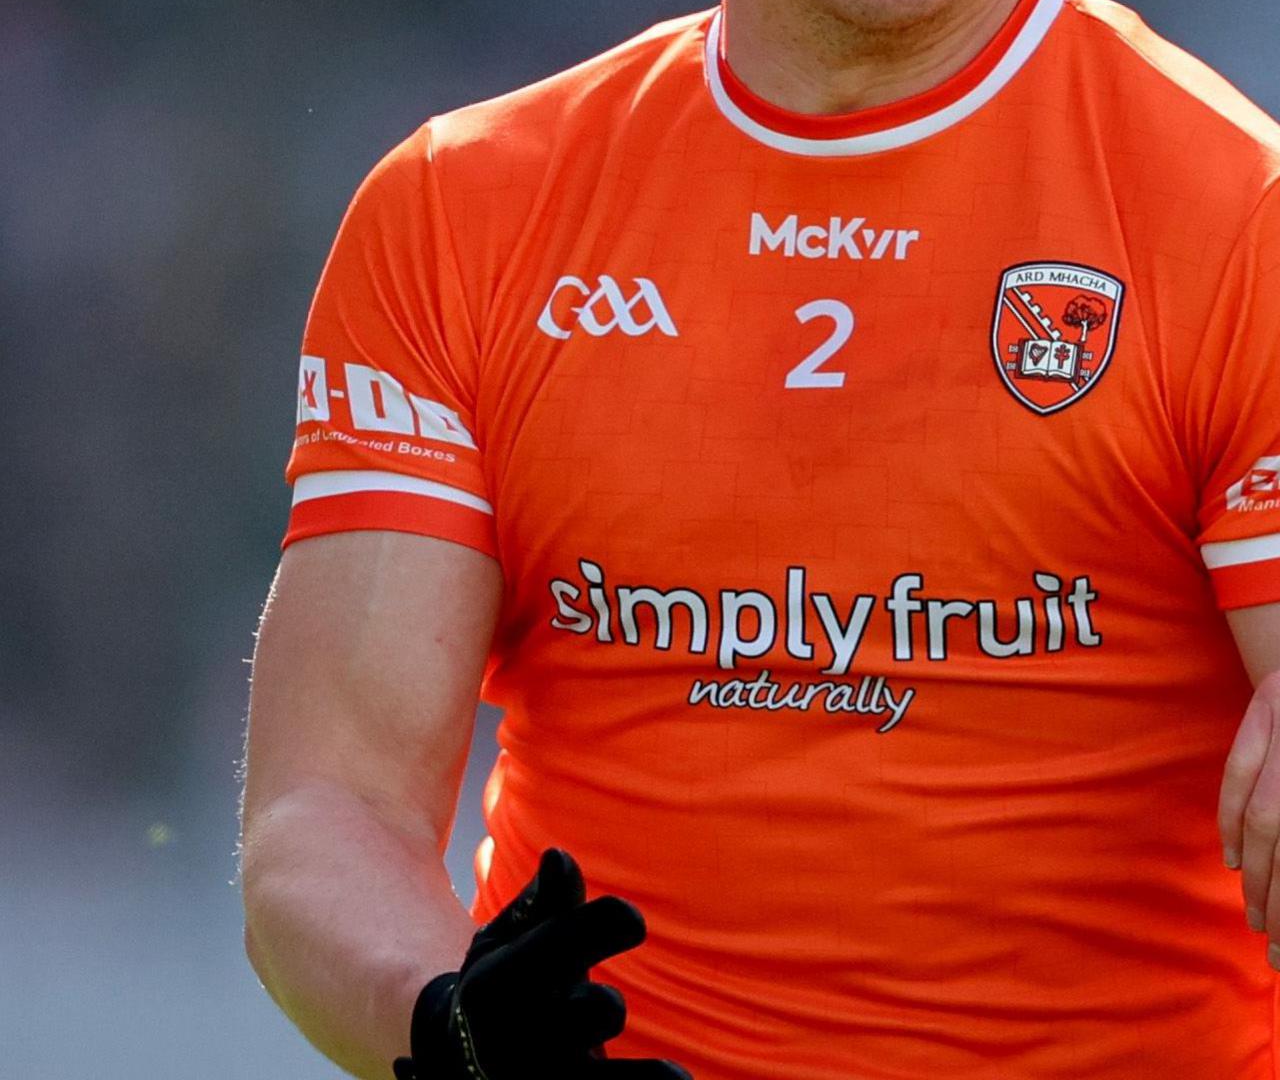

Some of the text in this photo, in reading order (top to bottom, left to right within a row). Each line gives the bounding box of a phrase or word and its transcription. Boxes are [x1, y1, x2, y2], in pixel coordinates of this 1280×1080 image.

[1016, 271, 1106, 291] ARD MHACHA
[784, 300, 855, 389] 2
[398, 442, 455, 463] Boxes
[550, 558, 1101, 675] simply fruit
[687, 670, 915, 733] naturally
